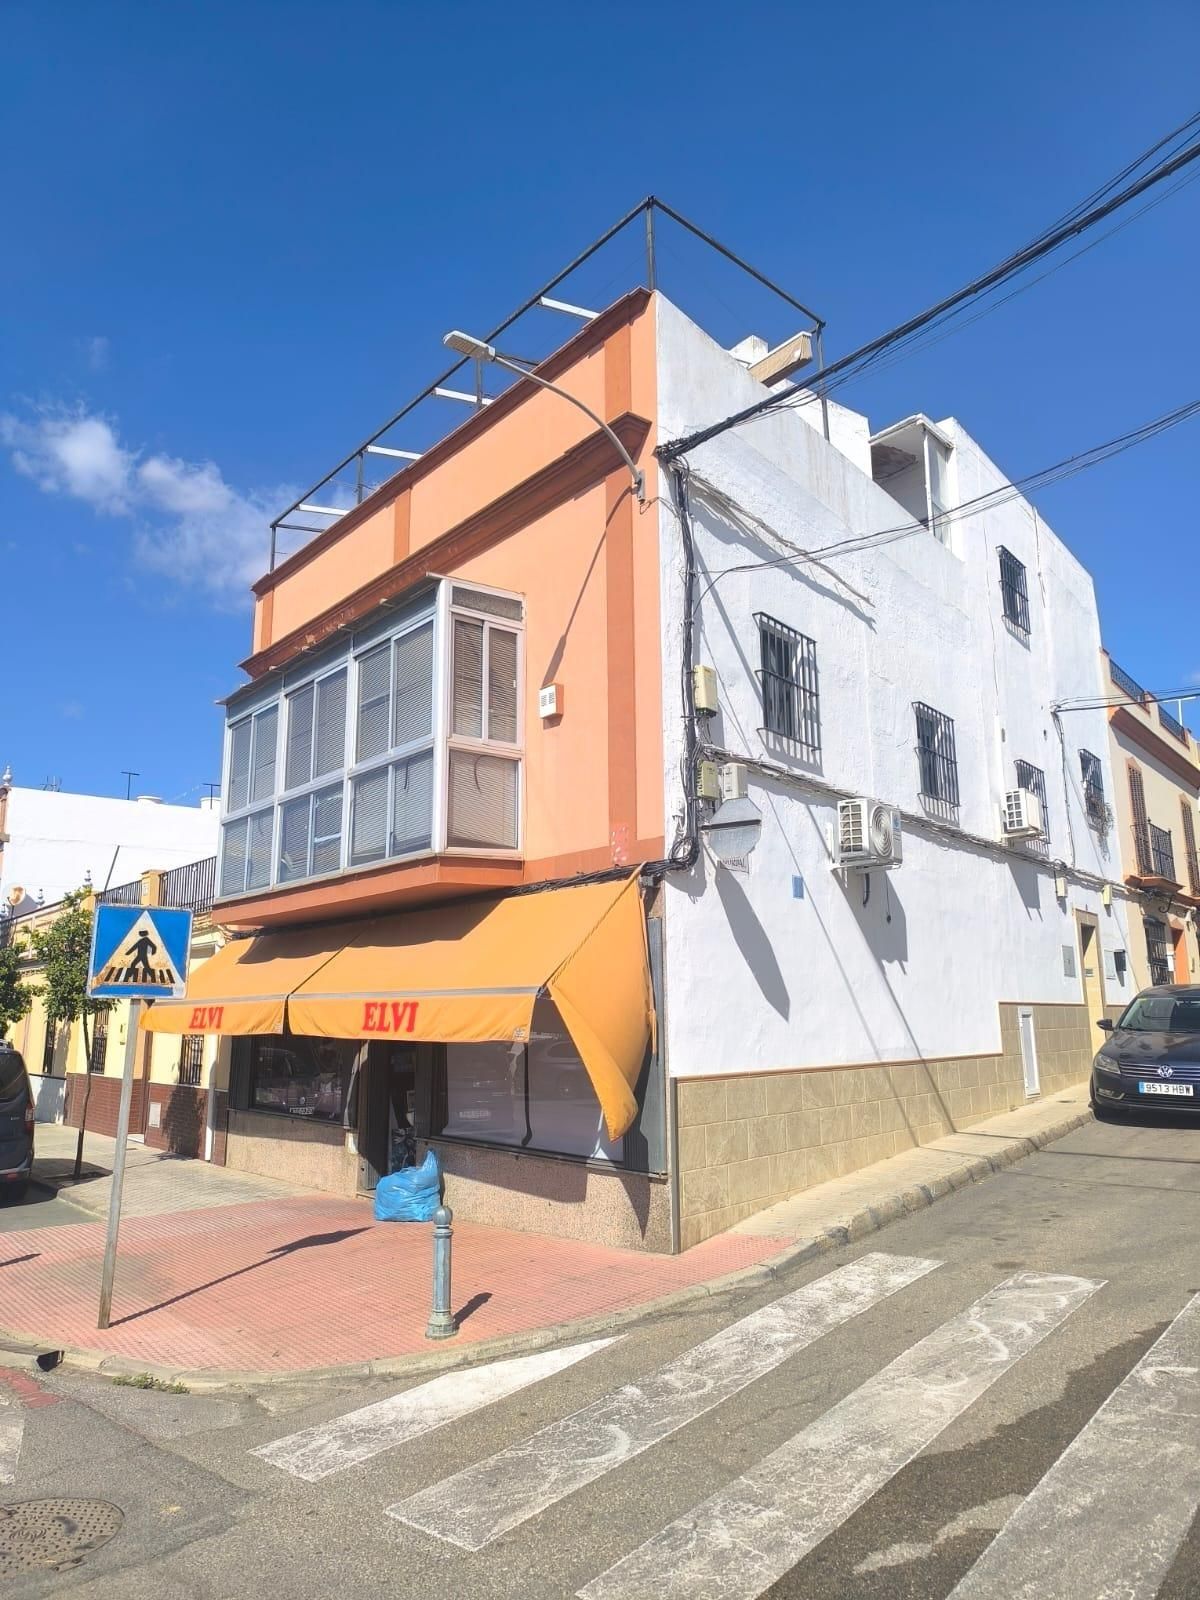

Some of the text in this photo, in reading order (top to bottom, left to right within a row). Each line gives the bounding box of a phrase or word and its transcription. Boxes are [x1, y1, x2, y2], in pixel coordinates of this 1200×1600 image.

[189, 1006, 224, 1030] ELVI
[362, 1002, 419, 1033] ELVI
[1145, 1083, 1191, 1095] 9513 HBW
